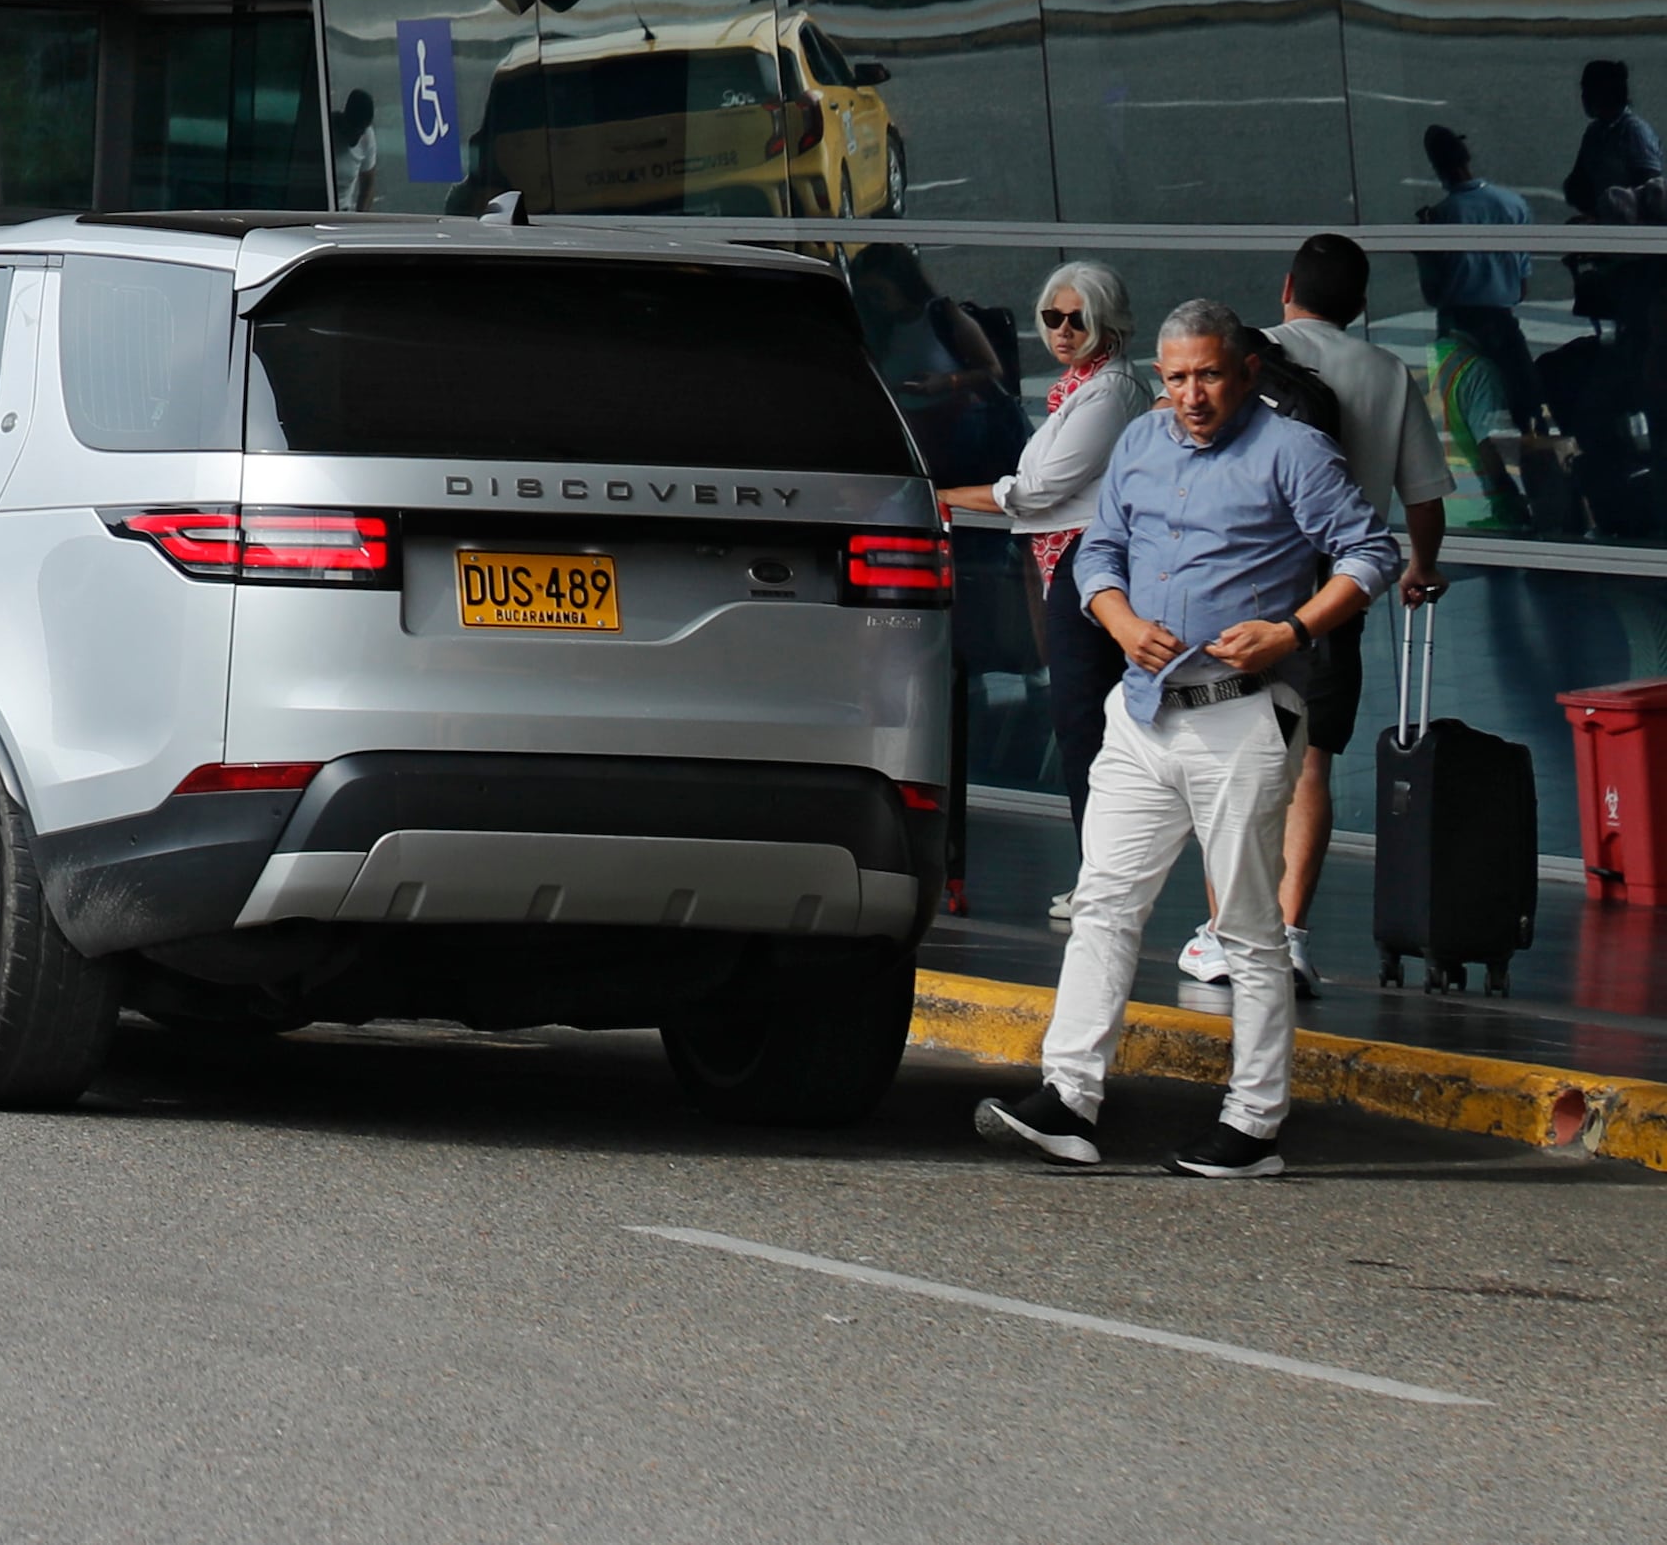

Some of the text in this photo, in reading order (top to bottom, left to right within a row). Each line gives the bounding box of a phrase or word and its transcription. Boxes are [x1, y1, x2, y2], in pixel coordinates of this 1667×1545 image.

[445, 476, 799, 507] DISCOVERY
[463, 564, 612, 610] DUS 489
[495, 608, 588, 625] BUCARAMANGA
